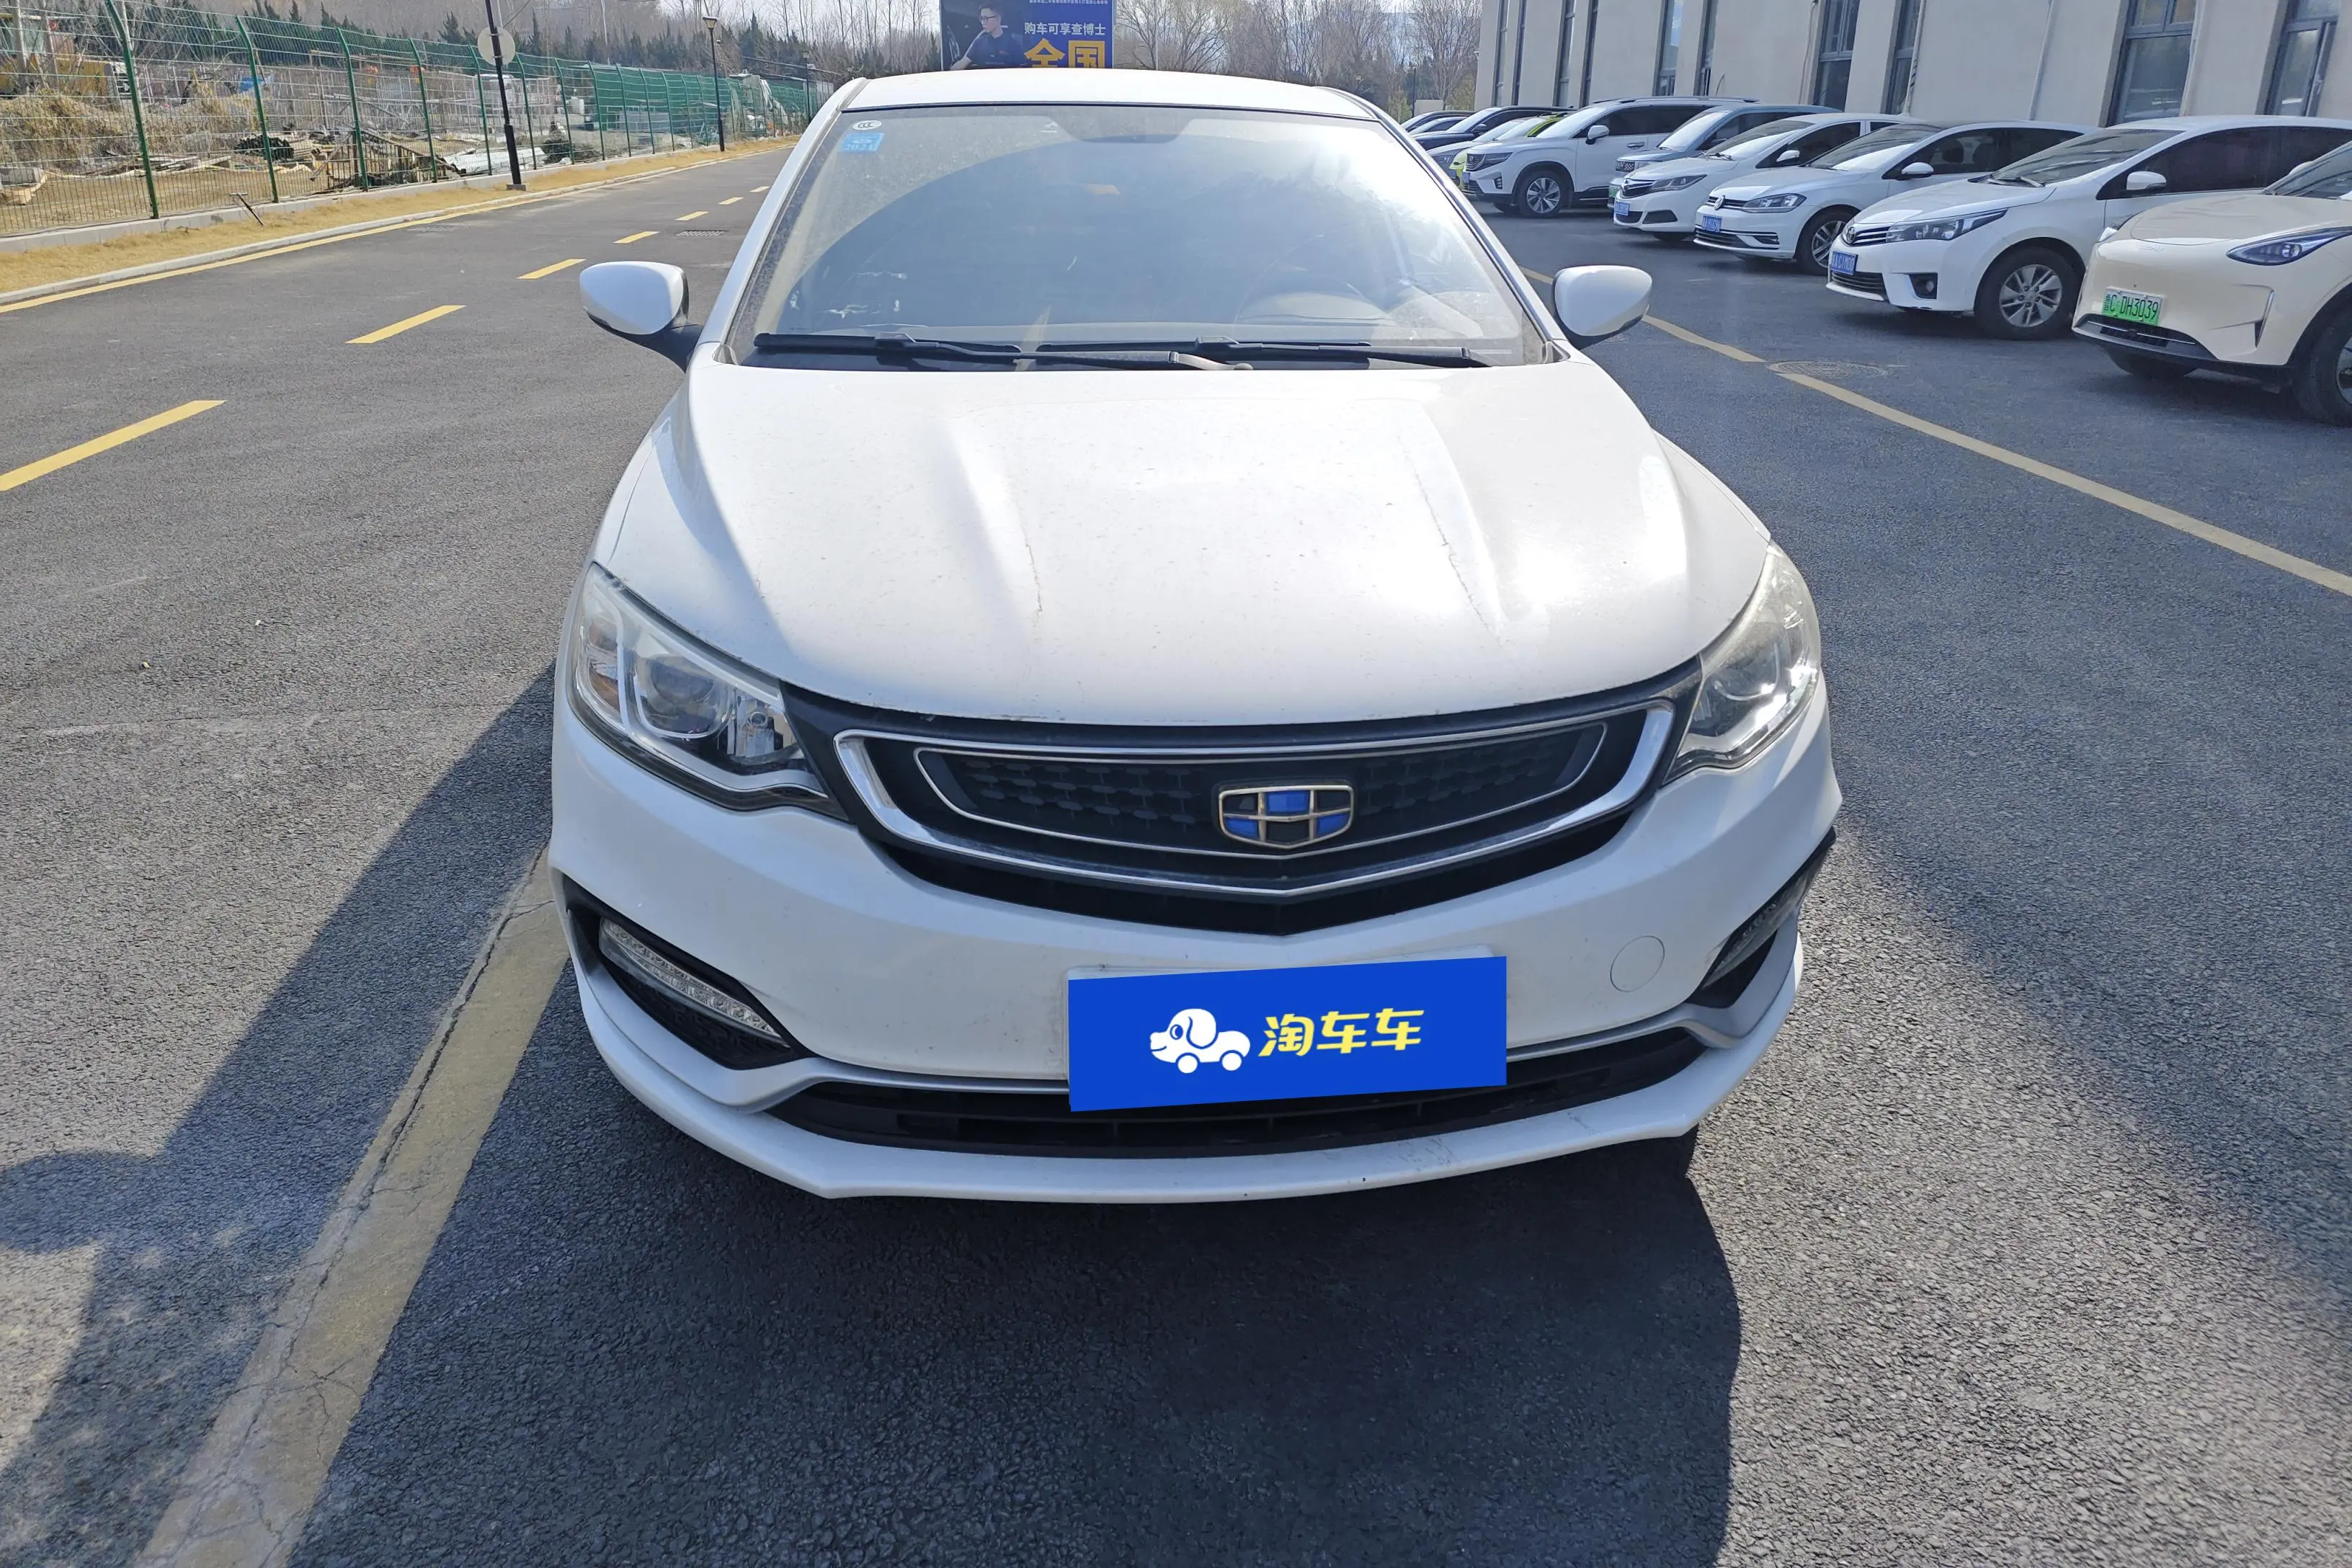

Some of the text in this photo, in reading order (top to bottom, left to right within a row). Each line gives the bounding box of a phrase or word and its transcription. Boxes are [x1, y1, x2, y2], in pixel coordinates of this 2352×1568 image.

[1024, 22, 1106, 35] 购车可享查博士
[1023, 38, 1105, 68] 全国
